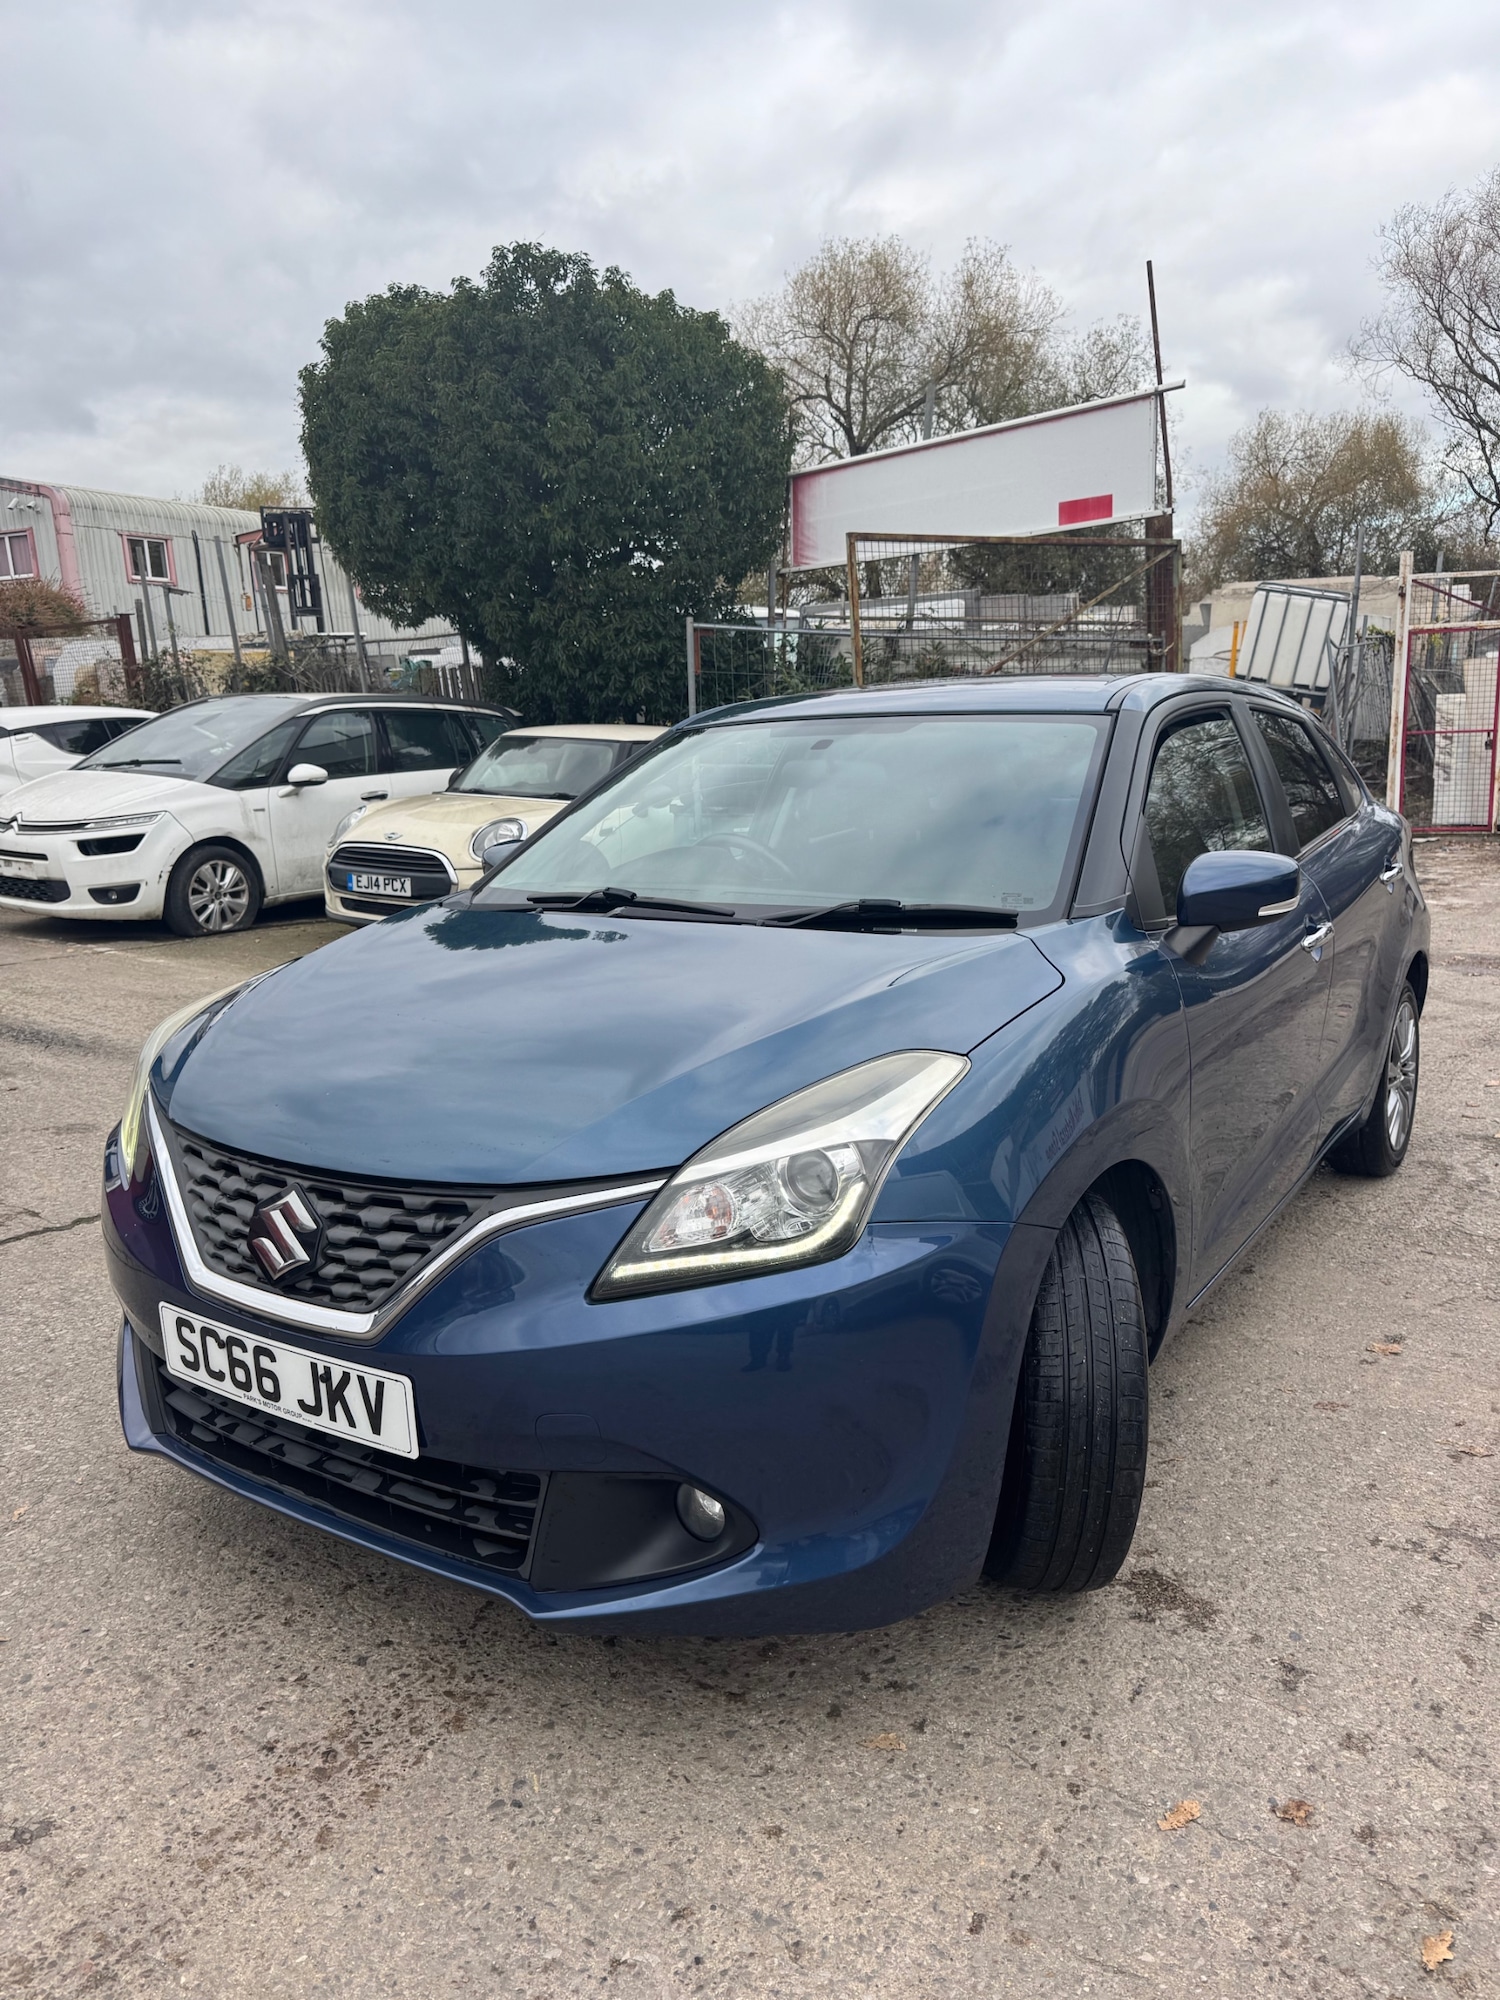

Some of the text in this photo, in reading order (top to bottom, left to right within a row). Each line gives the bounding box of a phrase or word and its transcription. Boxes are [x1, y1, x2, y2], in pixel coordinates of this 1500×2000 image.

[356, 875, 407, 893] EJ14 PCX
[175, 1316, 385, 1437] SC66 JKV
[243, 1393, 303, 1418] PARK'S MOTOR GROUP
